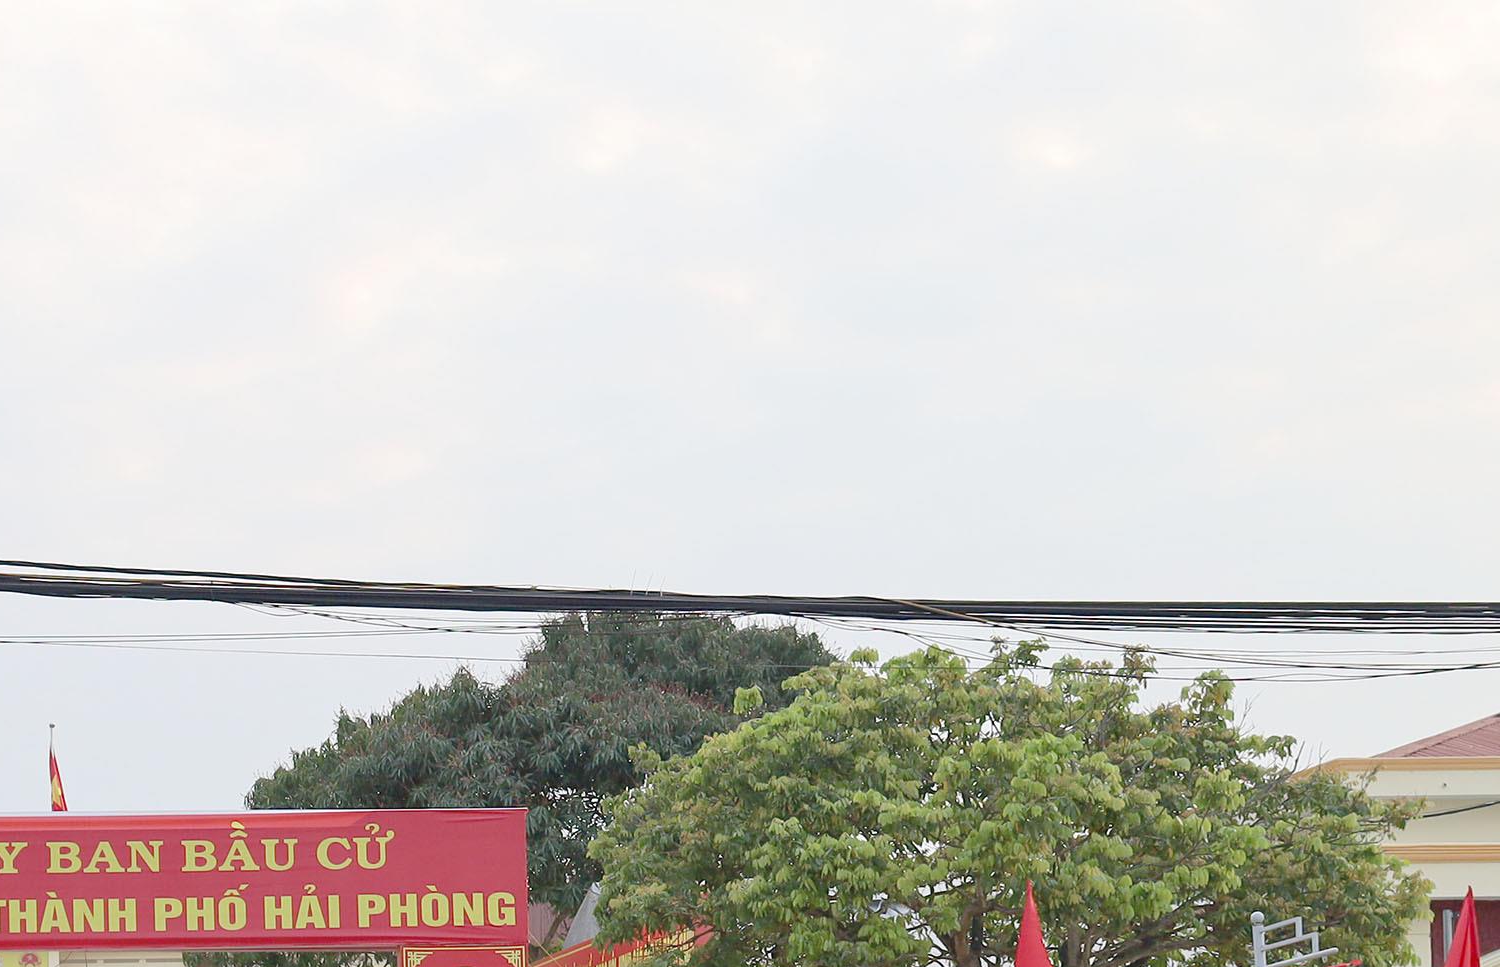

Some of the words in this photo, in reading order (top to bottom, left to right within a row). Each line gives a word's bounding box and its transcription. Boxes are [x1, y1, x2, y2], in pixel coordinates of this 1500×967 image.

[46, 841, 163, 873] BAN
[181, 822, 297, 871] BẦU
[317, 824, 394, 869] CỬ
[155, 884, 248, 931] PHỐ
[264, 885, 340, 929] HẢI
[358, 892, 515, 927] PHÒNG
